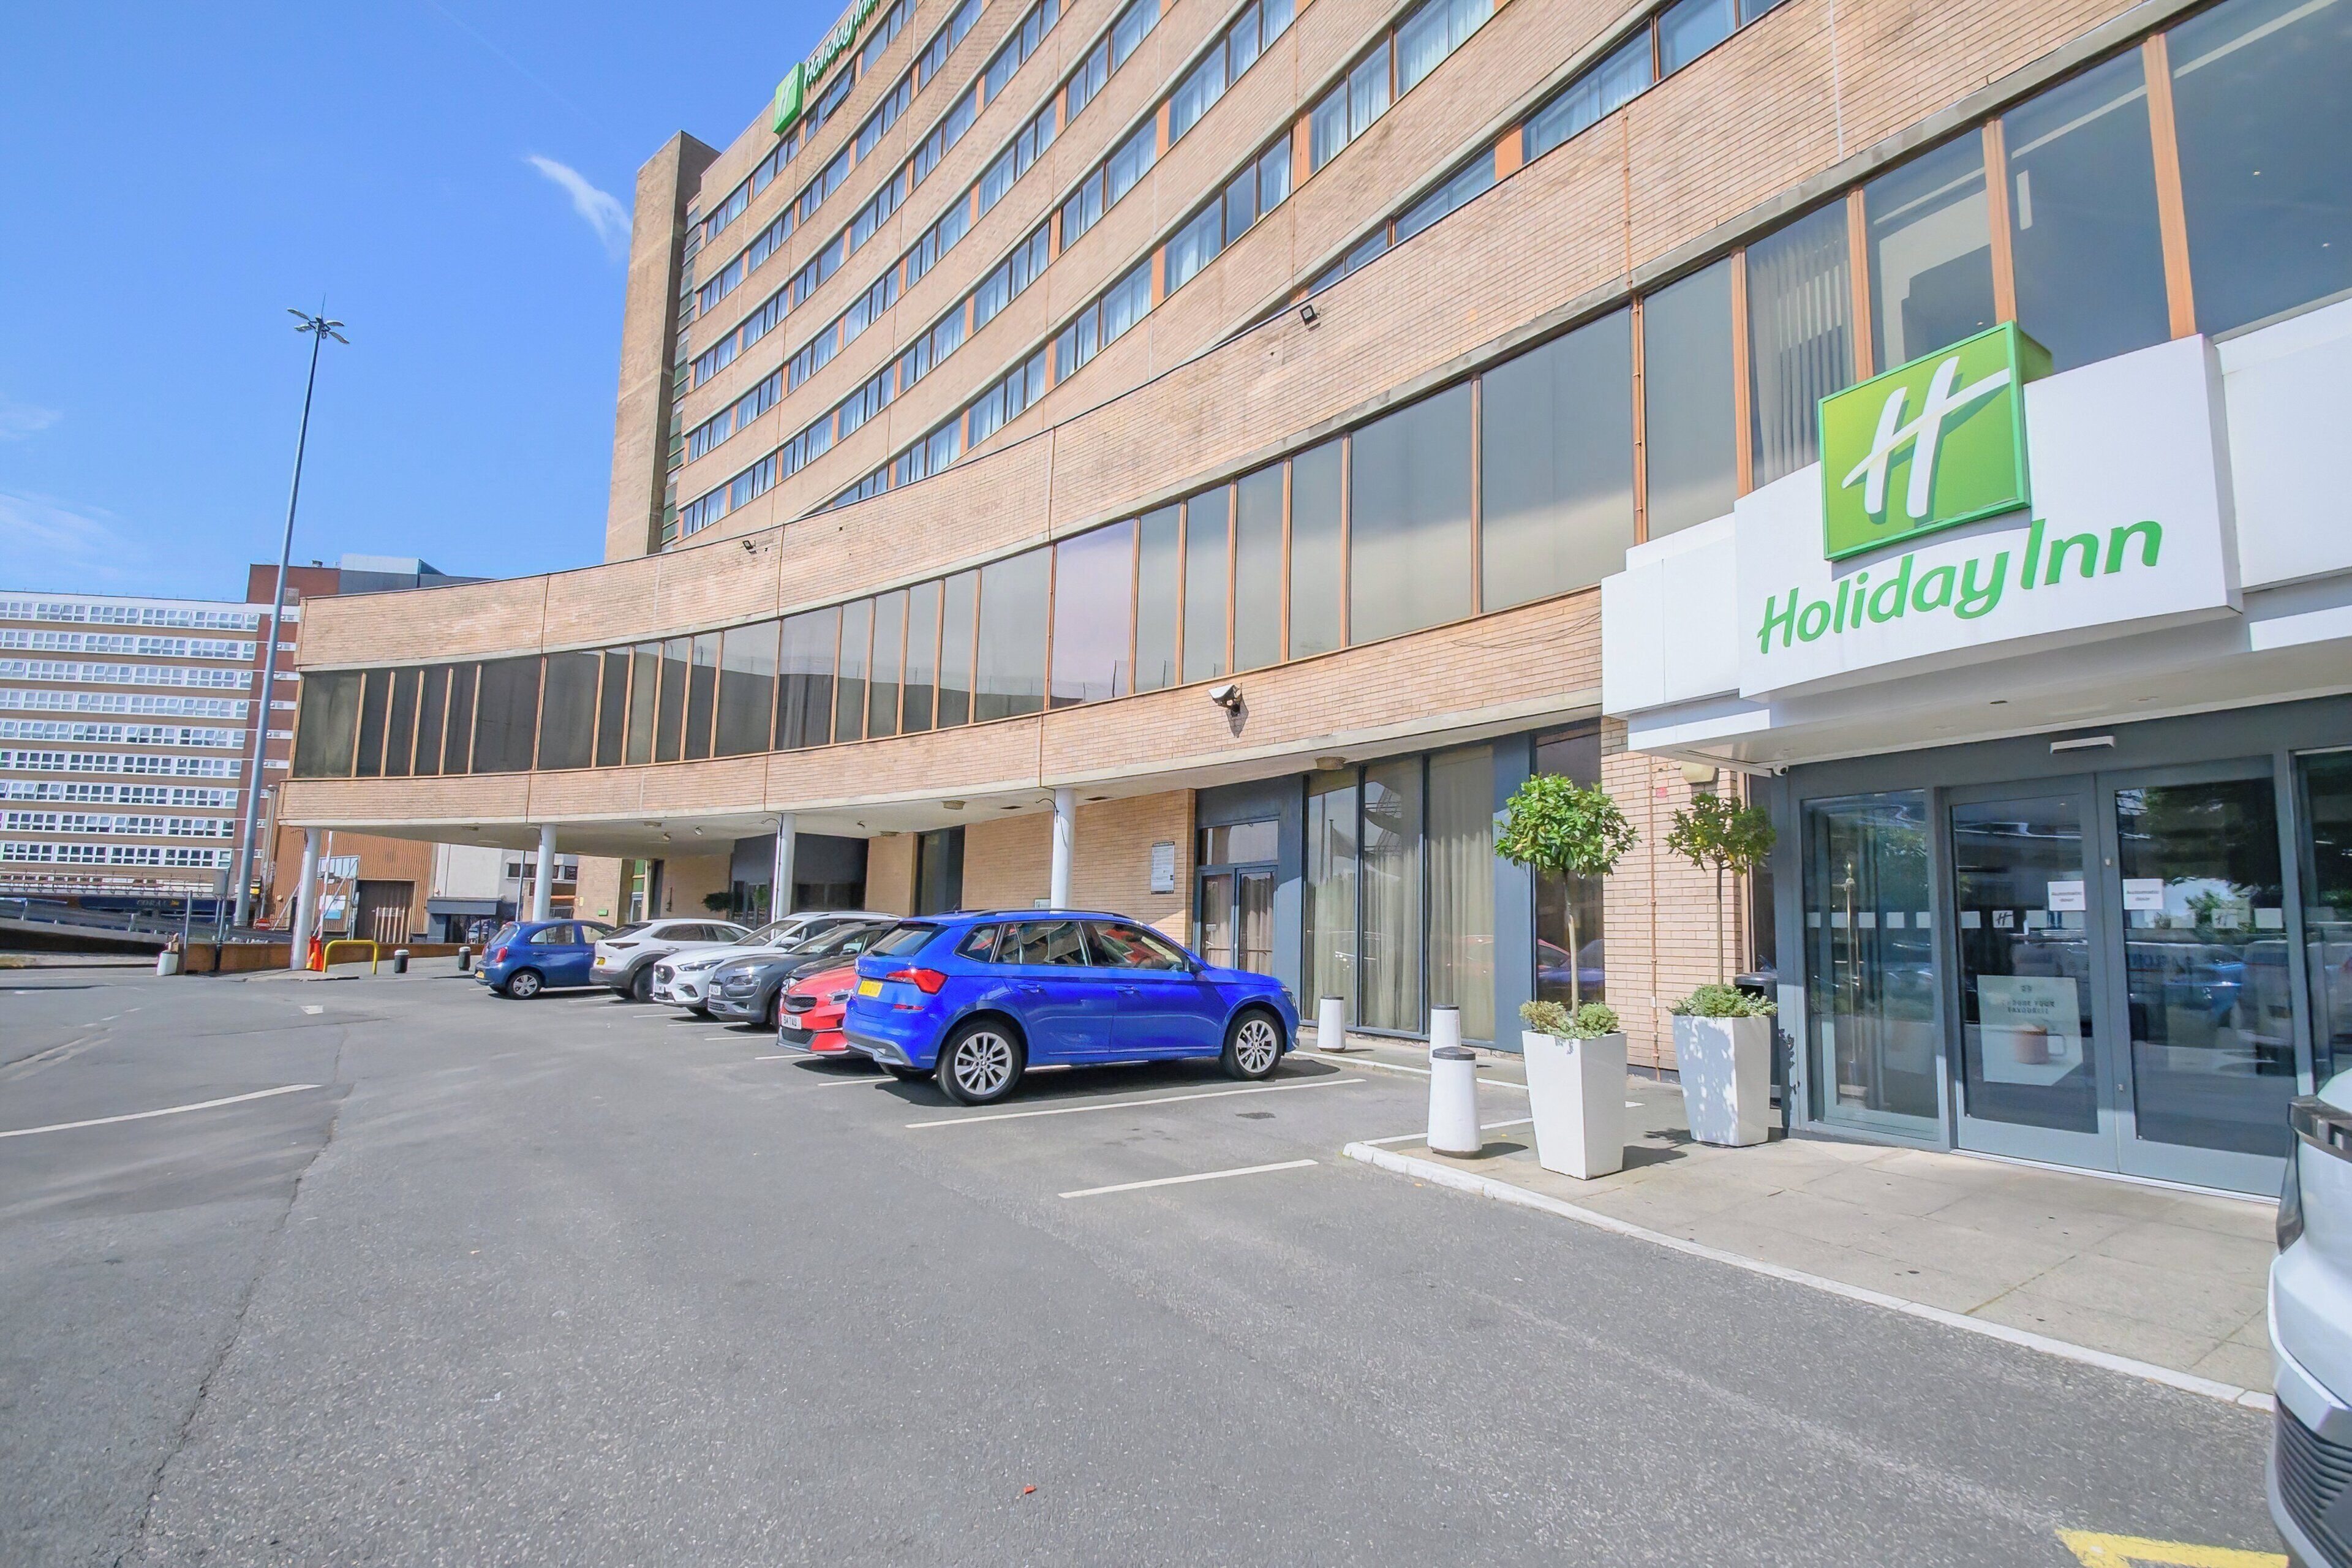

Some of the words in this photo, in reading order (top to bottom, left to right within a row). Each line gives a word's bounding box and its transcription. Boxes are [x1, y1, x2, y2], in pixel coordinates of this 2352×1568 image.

[804, 13, 854, 89] Holiday
[1757, 551, 2010, 654] Holiday
[2020, 518, 2163, 590] Inn
